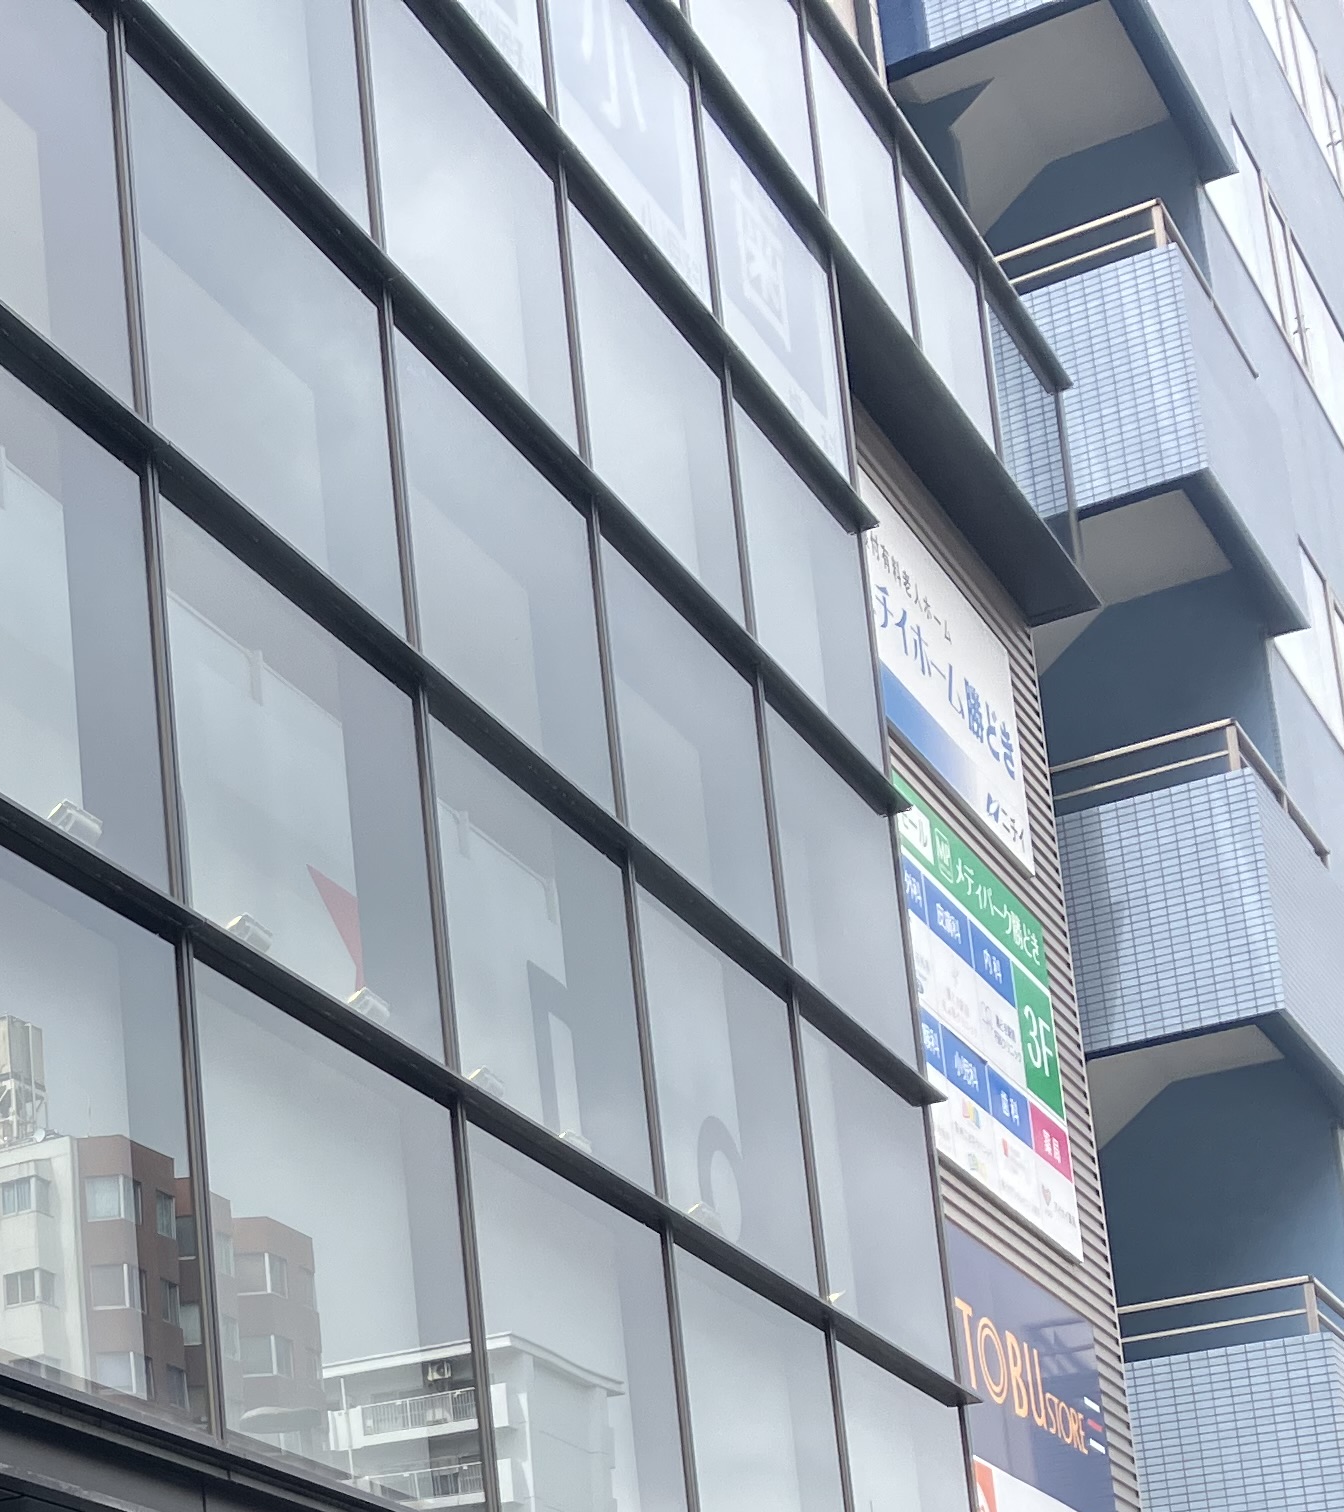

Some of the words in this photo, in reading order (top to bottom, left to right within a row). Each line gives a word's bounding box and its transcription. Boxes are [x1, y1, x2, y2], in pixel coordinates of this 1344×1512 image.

[866, 530, 952, 645] 付有料老人ホーム
[874, 584, 1015, 780] チイホーム勝どき
[1023, 1005, 1053, 1078] 3F
[954, 1297, 1047, 1428] TOBU
[1045, 1392, 1088, 1455] STORE
